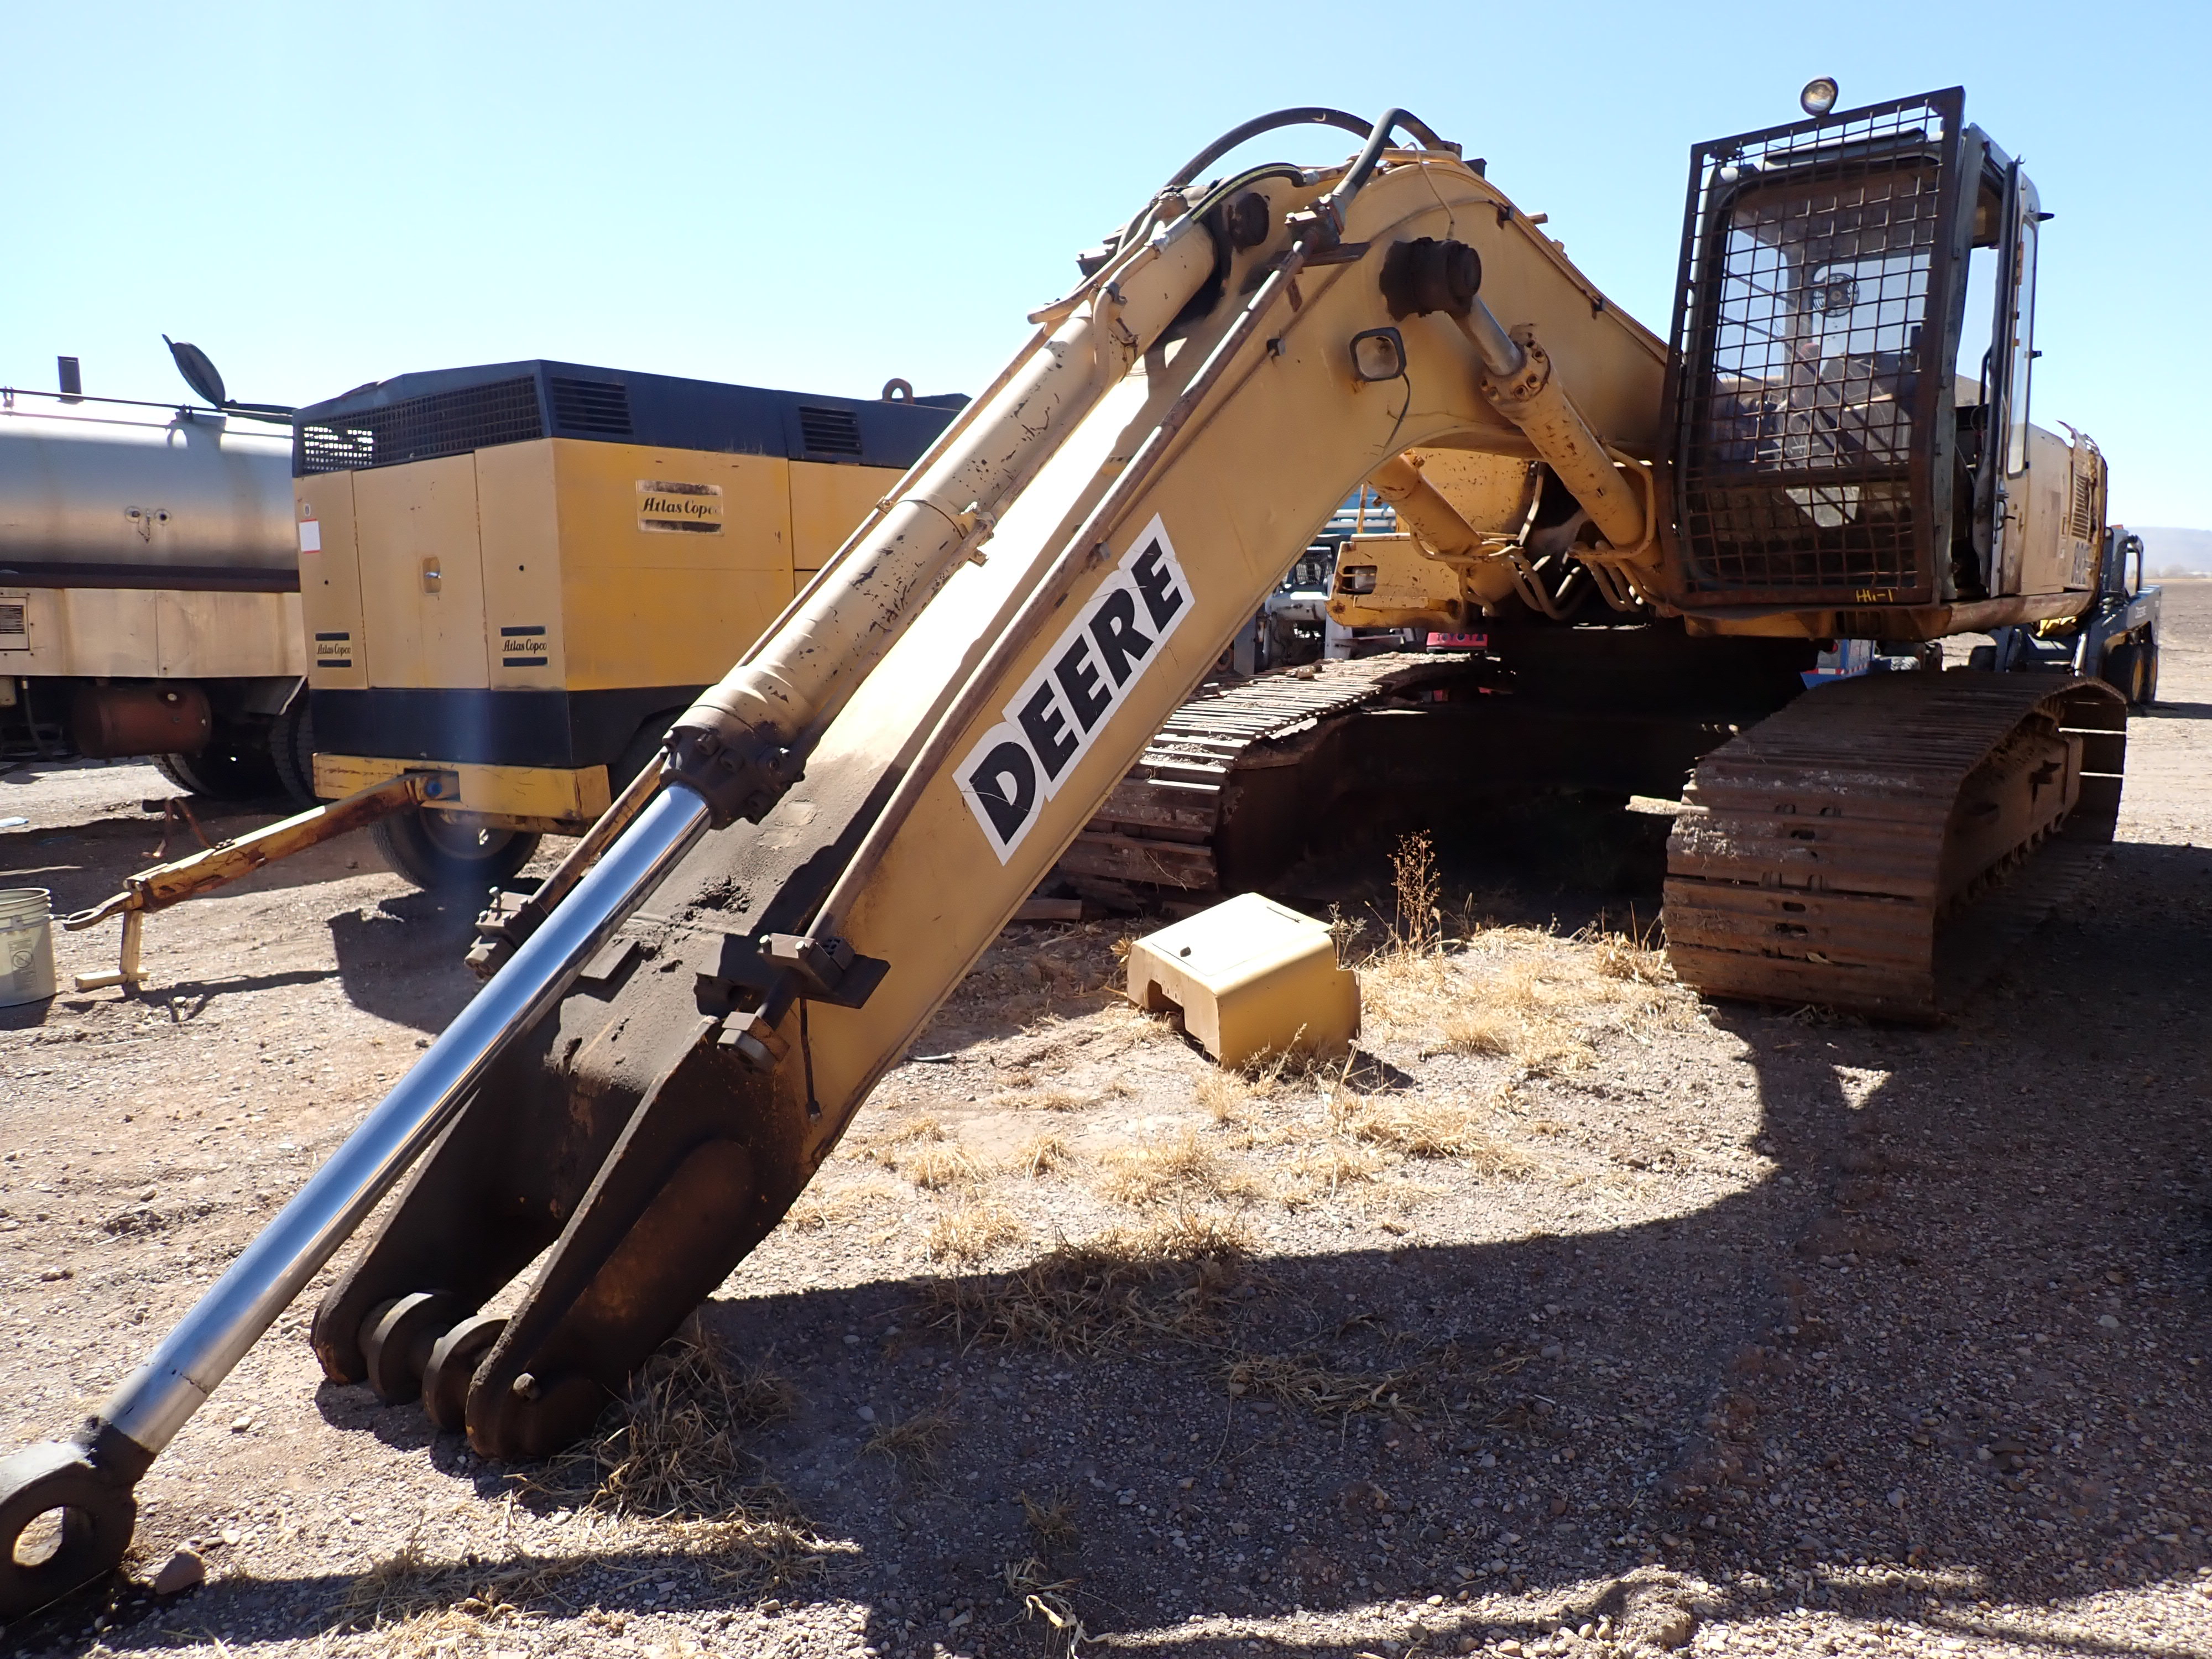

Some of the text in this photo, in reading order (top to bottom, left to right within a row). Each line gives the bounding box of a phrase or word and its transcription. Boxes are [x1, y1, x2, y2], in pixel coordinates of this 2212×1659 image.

[641, 497, 721, 518] Atlas Copc
[1437, 632, 1484, 641] TOYOTA
[317, 643, 351, 656] Atlas Copco
[502, 639, 547, 654] Atlas Copco
[968, 537, 1184, 846] DEERE
